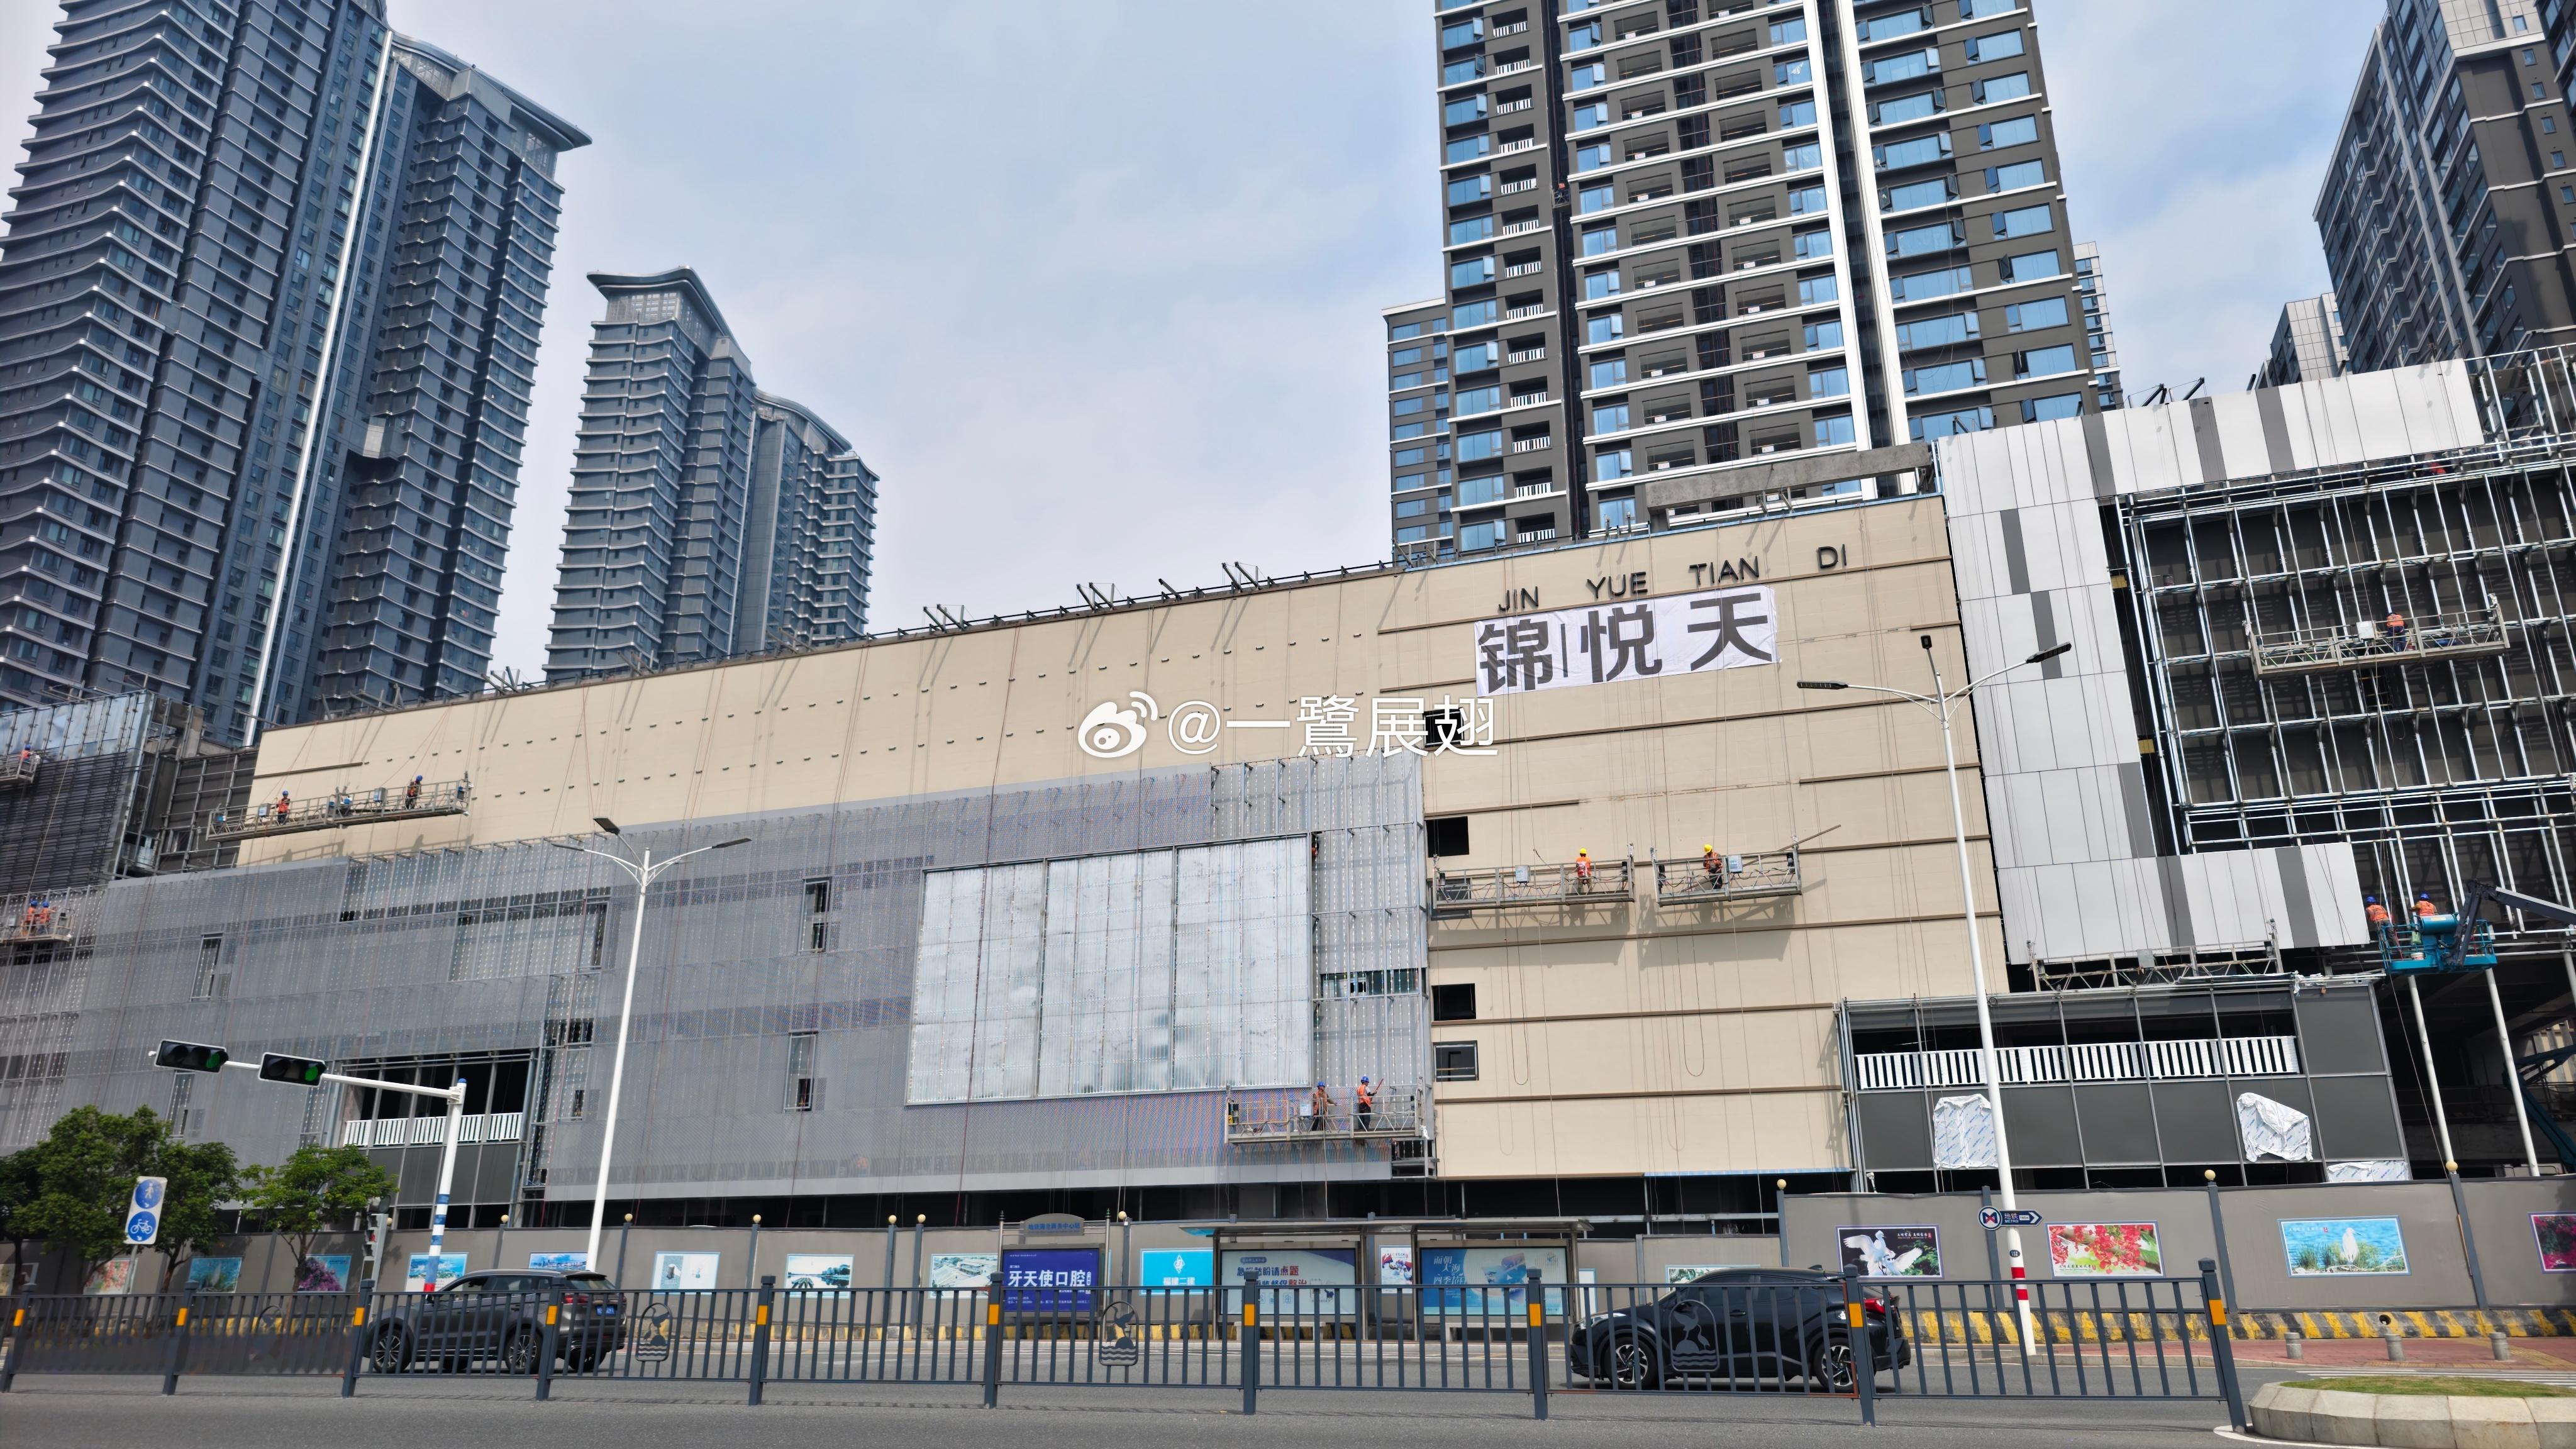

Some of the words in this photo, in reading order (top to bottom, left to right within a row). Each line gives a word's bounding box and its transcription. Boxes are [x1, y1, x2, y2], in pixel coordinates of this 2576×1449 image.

[1497, 586, 1540, 611] JIN
[1585, 570, 1648, 599] YUE
[1689, 555, 1760, 586] TIAN
[1816, 543, 1848, 569] DI
[1008, 1269, 1085, 1287] 牙天使口腔
